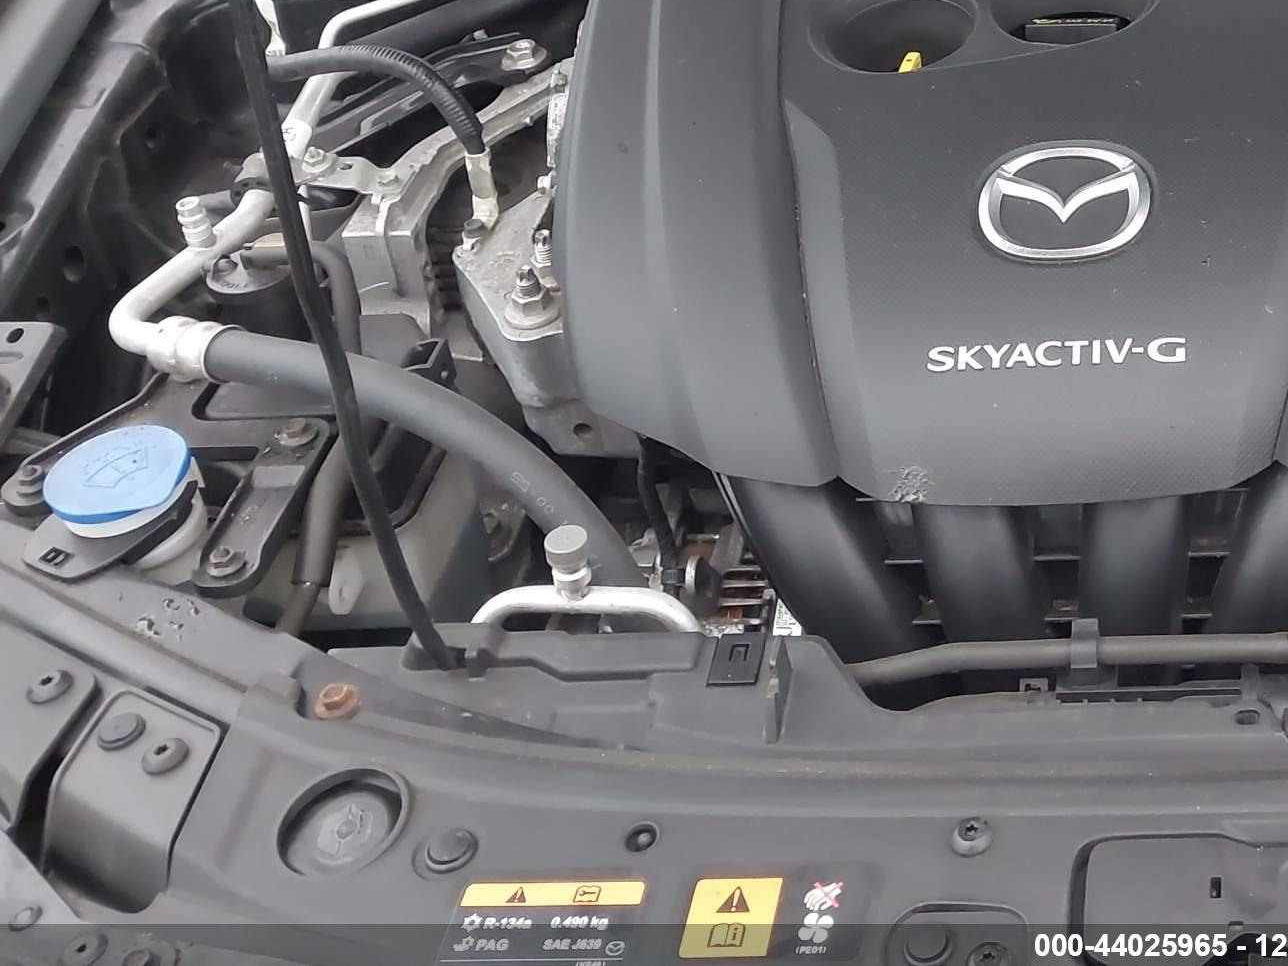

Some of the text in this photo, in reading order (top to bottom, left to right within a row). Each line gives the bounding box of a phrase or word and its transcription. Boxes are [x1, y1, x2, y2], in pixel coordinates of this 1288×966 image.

[926, 337, 1186, 372] SKYACTIV-G
[482, 915, 609, 931] R-134a 0.490 kg
[474, 938, 510, 952] PAG
[542, 938, 571, 951] SAE
